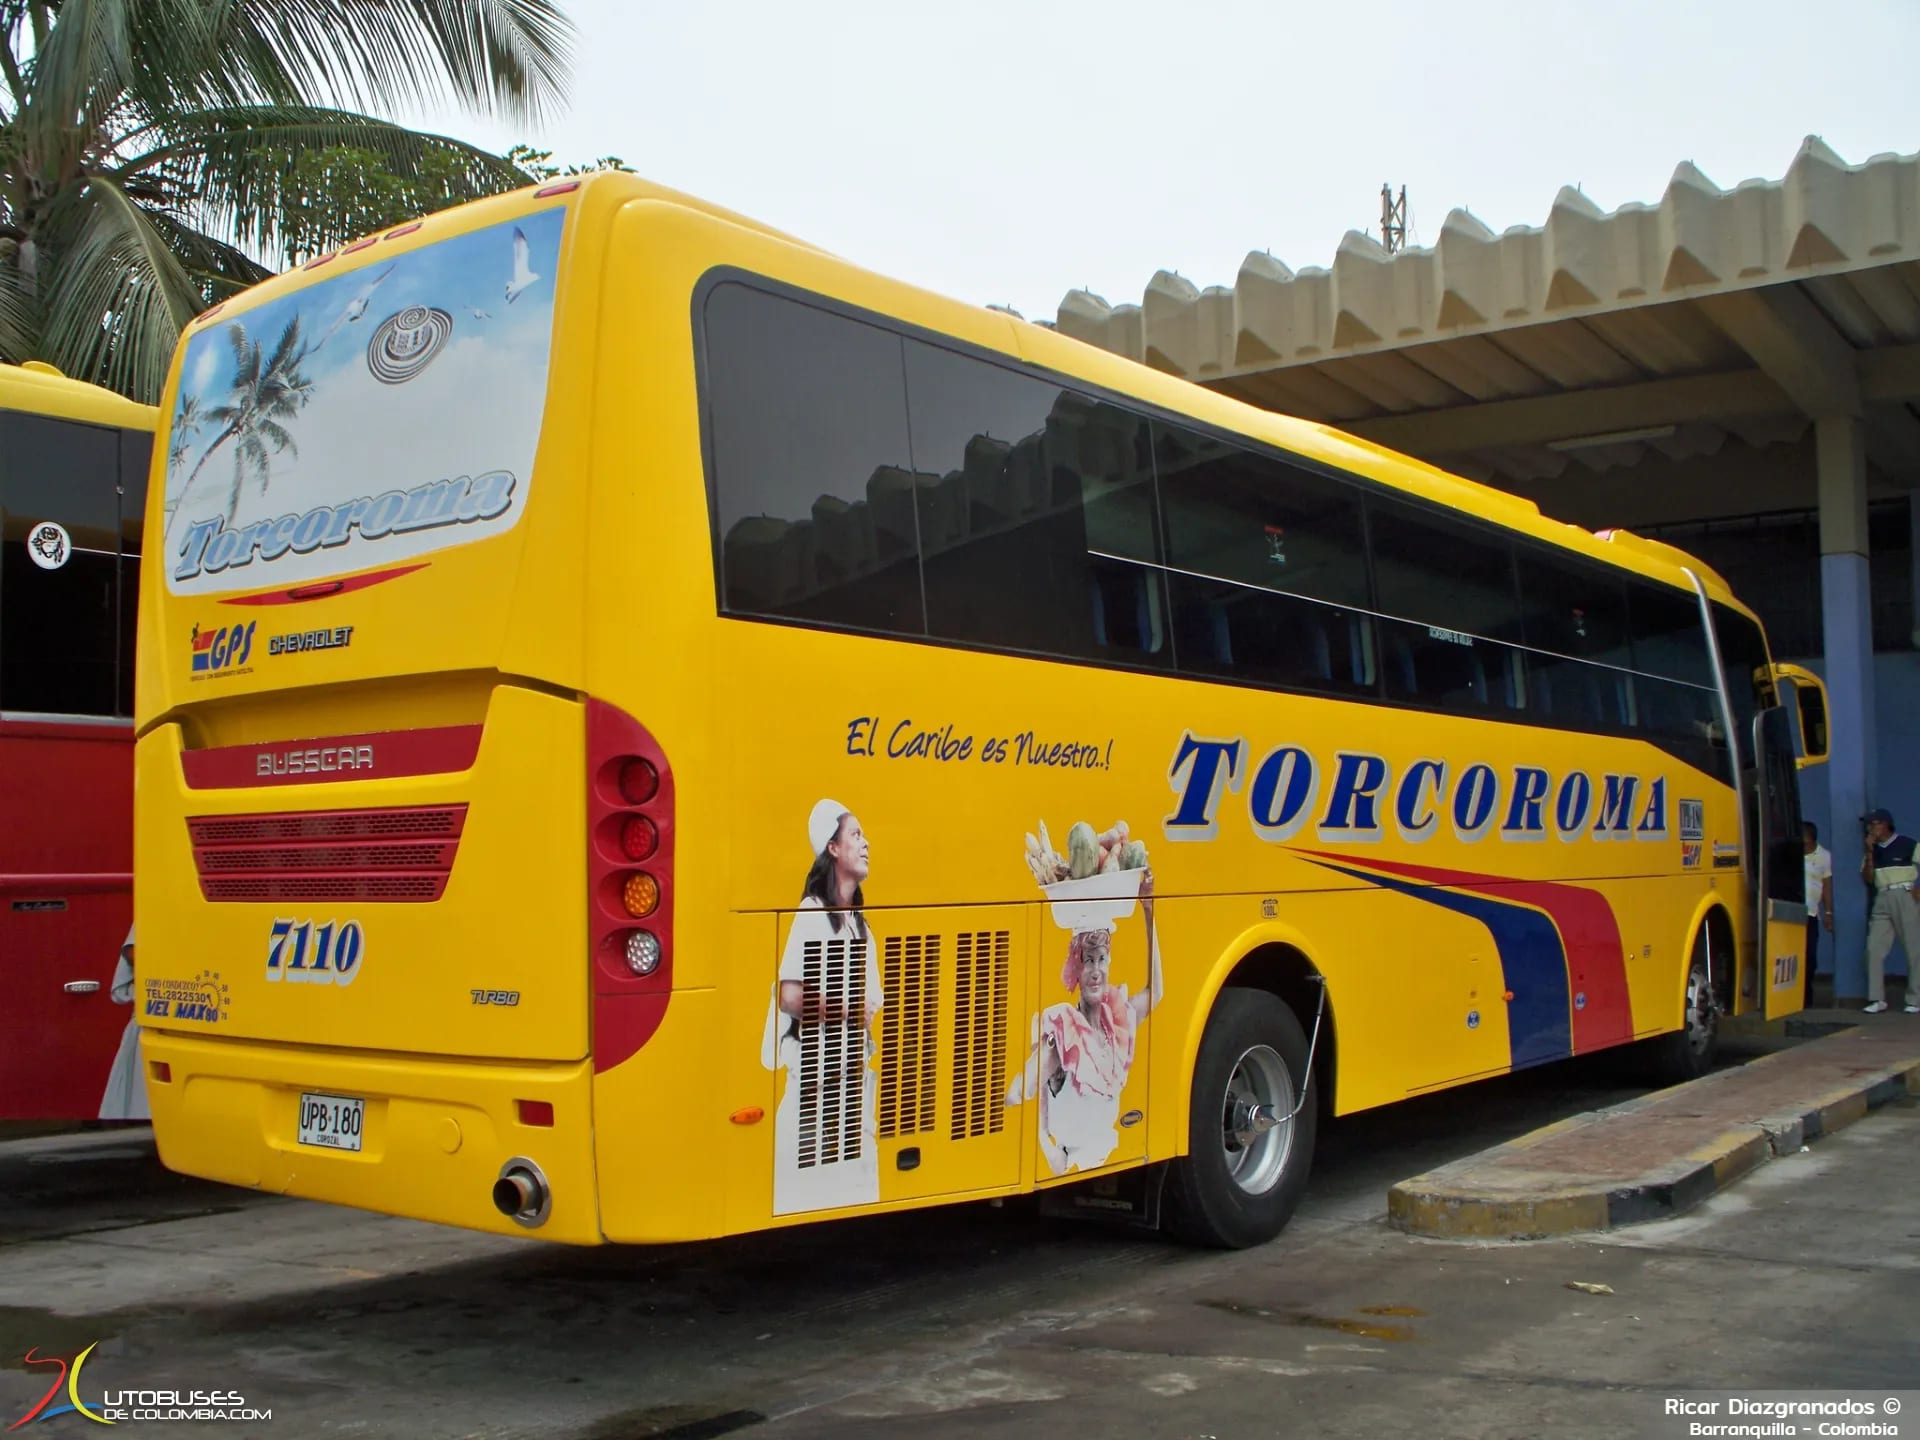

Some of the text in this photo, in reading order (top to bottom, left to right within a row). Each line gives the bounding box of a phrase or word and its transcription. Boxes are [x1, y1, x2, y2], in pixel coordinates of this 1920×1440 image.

[174, 470, 517, 581] Torcoroma
[211, 620, 257, 670] GPS
[268, 625, 354, 656] CHEVROLET
[847, 717, 880, 756] El
[887, 719, 973, 762] Caribe
[981, 737, 1009, 763] es
[256, 745, 373, 776] BUSSCAR
[1163, 729, 1669, 843] TORCOROMA
[265, 916, 364, 986] 7110
[1773, 954, 1798, 988] 7110
[145, 1000, 170, 1017] VEL
[175, 1002, 206, 1021] MAX
[471, 989, 520, 1006] TURBO
